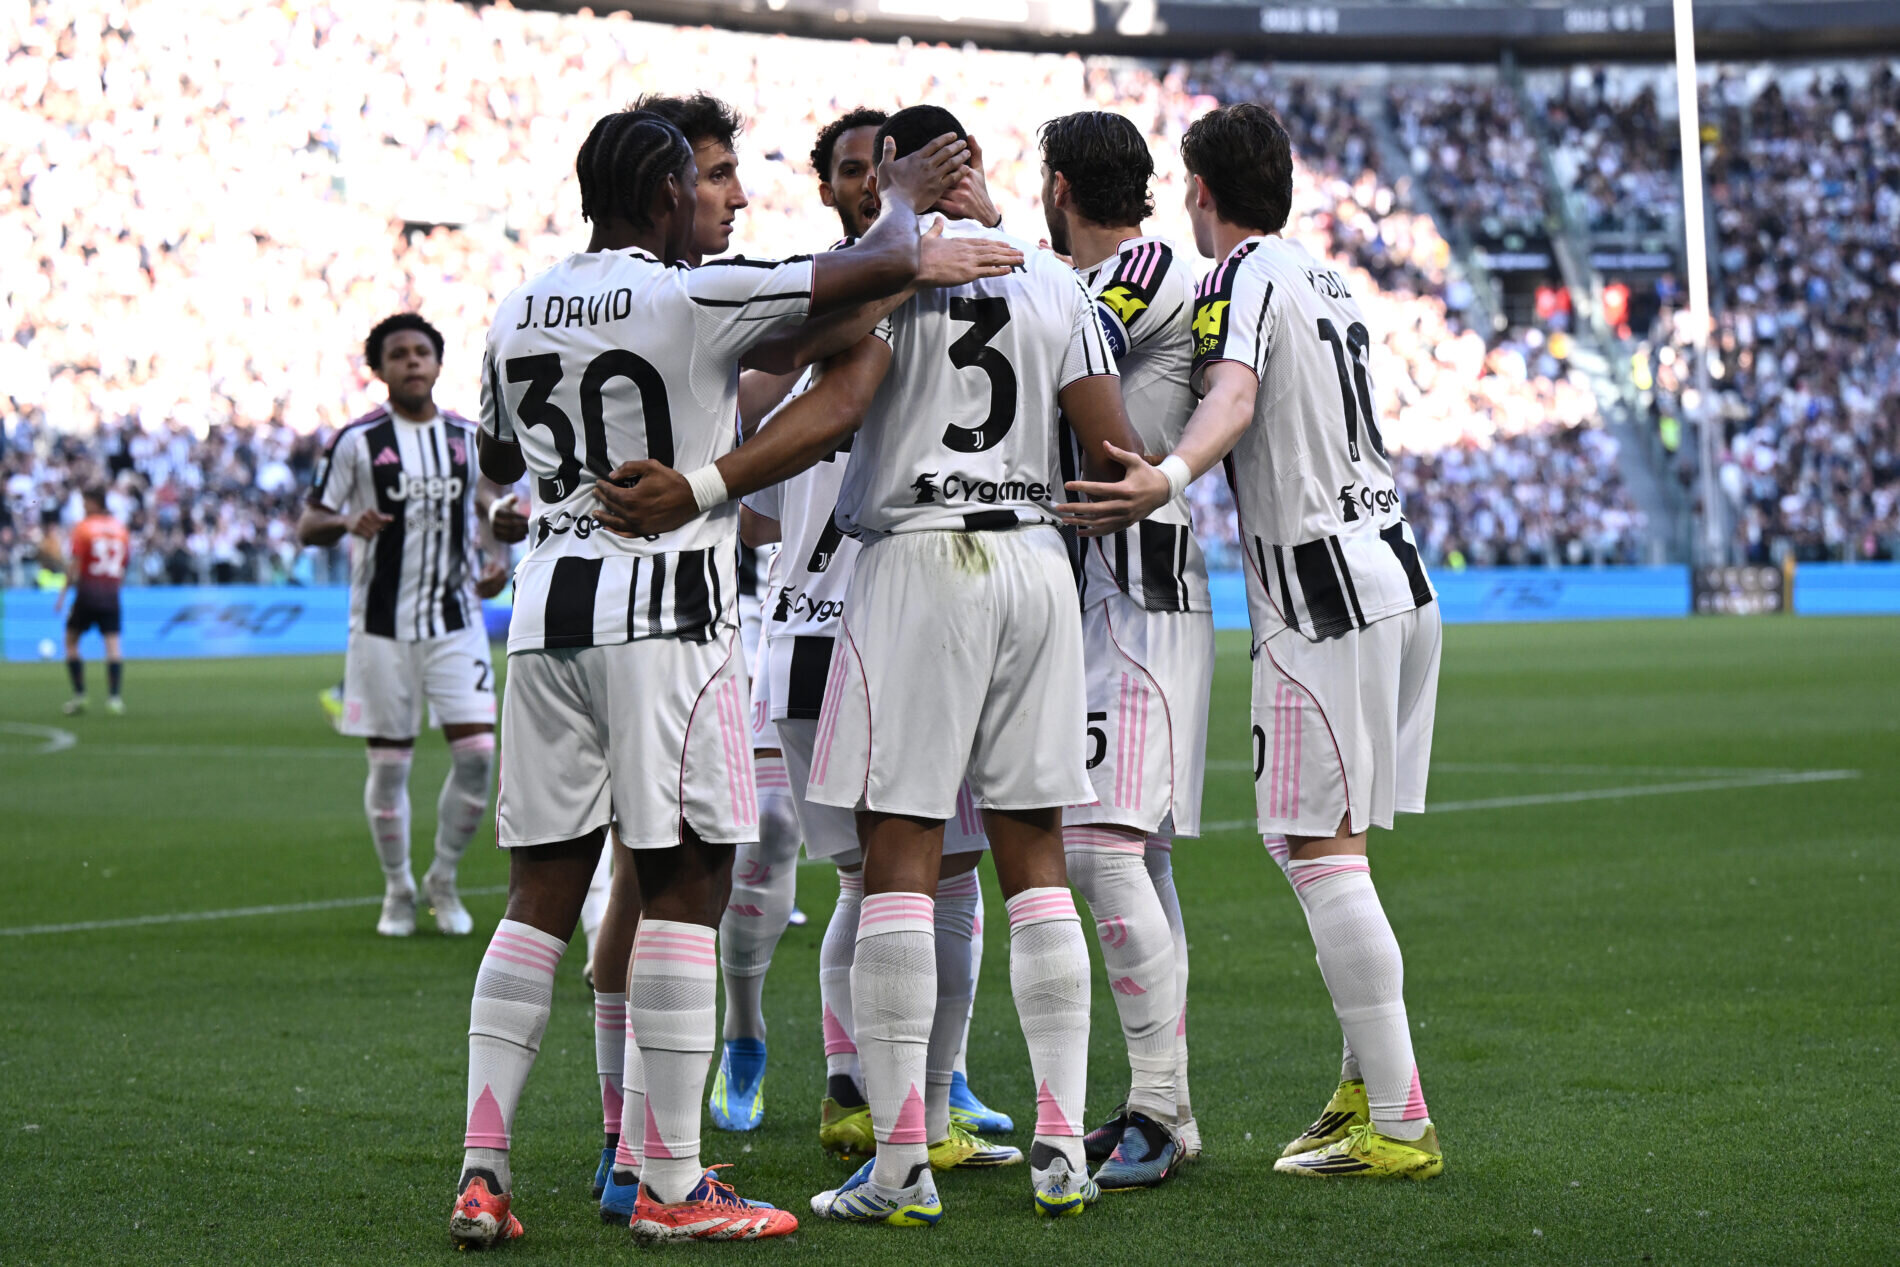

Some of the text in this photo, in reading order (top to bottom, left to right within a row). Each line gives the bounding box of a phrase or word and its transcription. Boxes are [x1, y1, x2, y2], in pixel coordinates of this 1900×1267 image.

[516, 287, 633, 330] J.DAVID
[942, 296, 1017, 453] 3
[505, 348, 675, 504] 30
[1316, 318, 1386, 462] 10
[386, 470, 463, 507] Jeep
